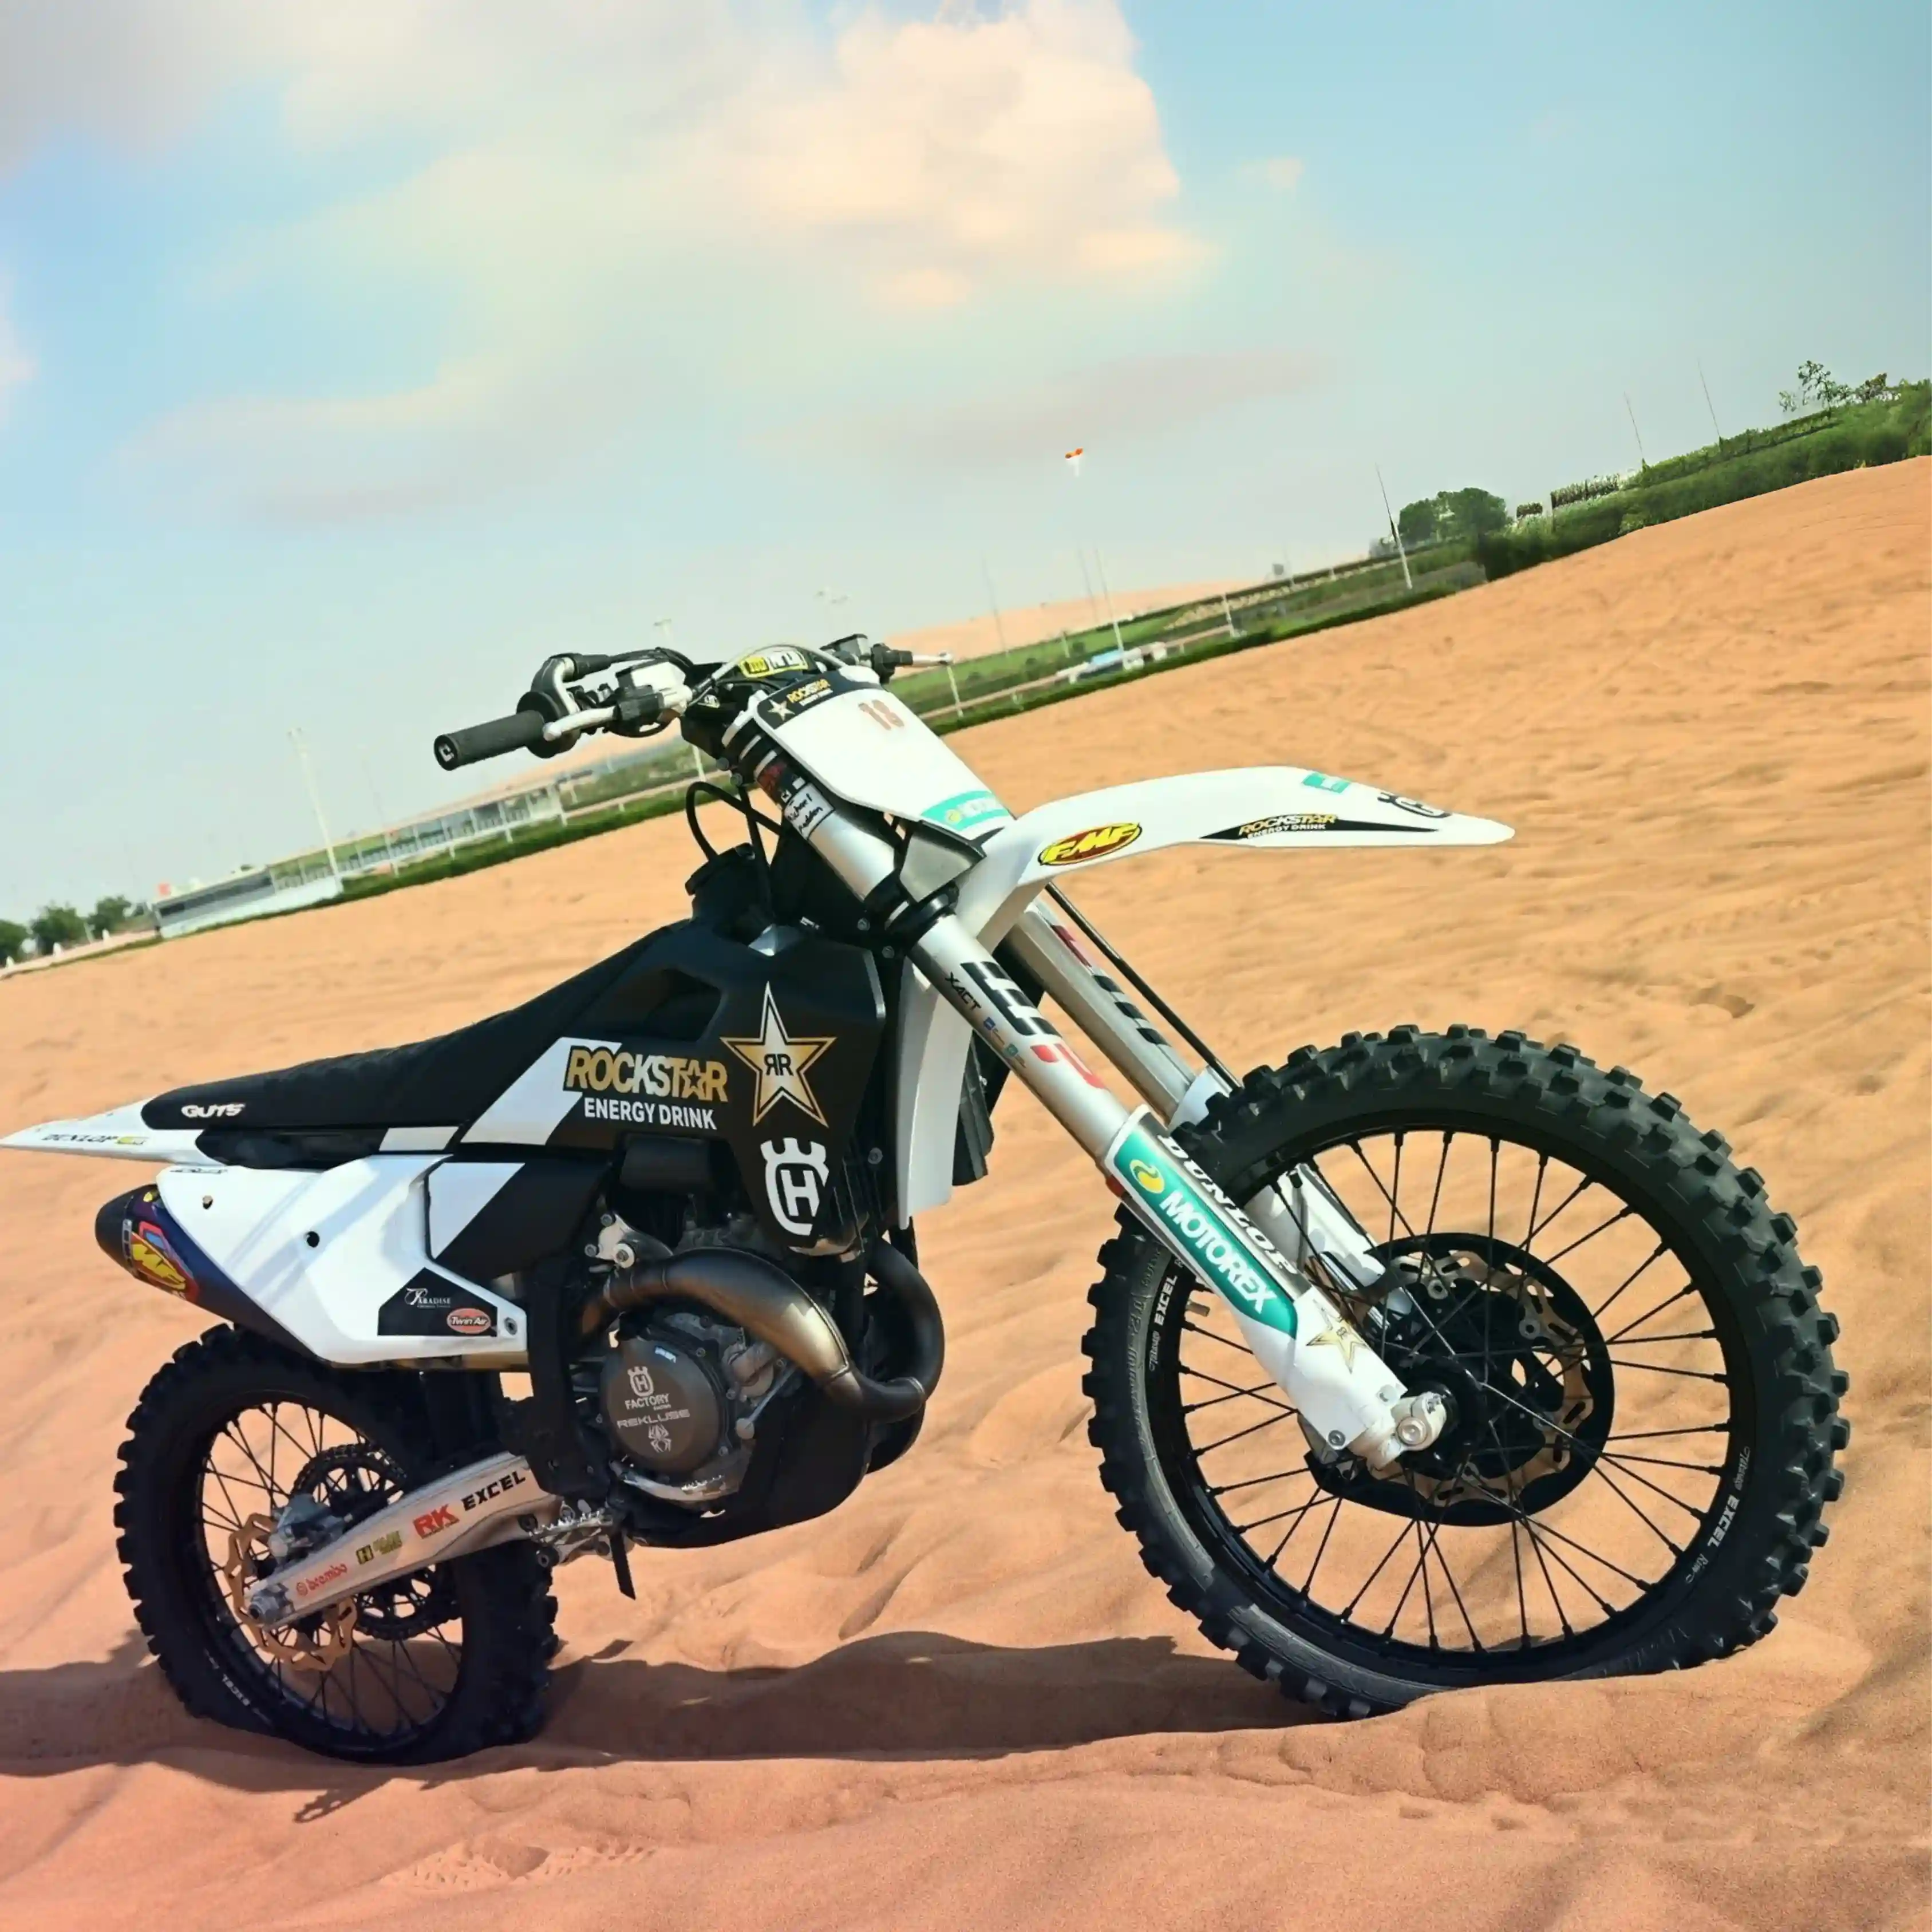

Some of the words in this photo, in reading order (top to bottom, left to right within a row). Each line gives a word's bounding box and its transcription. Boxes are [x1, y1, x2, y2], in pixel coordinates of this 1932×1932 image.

[1238, 813, 1337, 836] ROCKSTAR
[1043, 822, 1137, 863] FMF
[566, 1046, 729, 1103] ROCKSTAR
[181, 1104, 246, 1118] GUTS
[584, 1097, 655, 1123] ENERGY
[658, 1103, 717, 1129] DRINK
[1159, 1190, 1278, 1314] MOTOREX
[1154, 1275, 1178, 1326] EXCEL
[452, 1317, 473, 1325] Twin
[625, 1393, 670, 1410] FACTORY
[461, 1471, 526, 1512] EXCEL
[413, 1504, 460, 1538] RK
[1707, 1495, 1741, 1547] EXCEL
[305, 1562, 349, 1592] brembo
